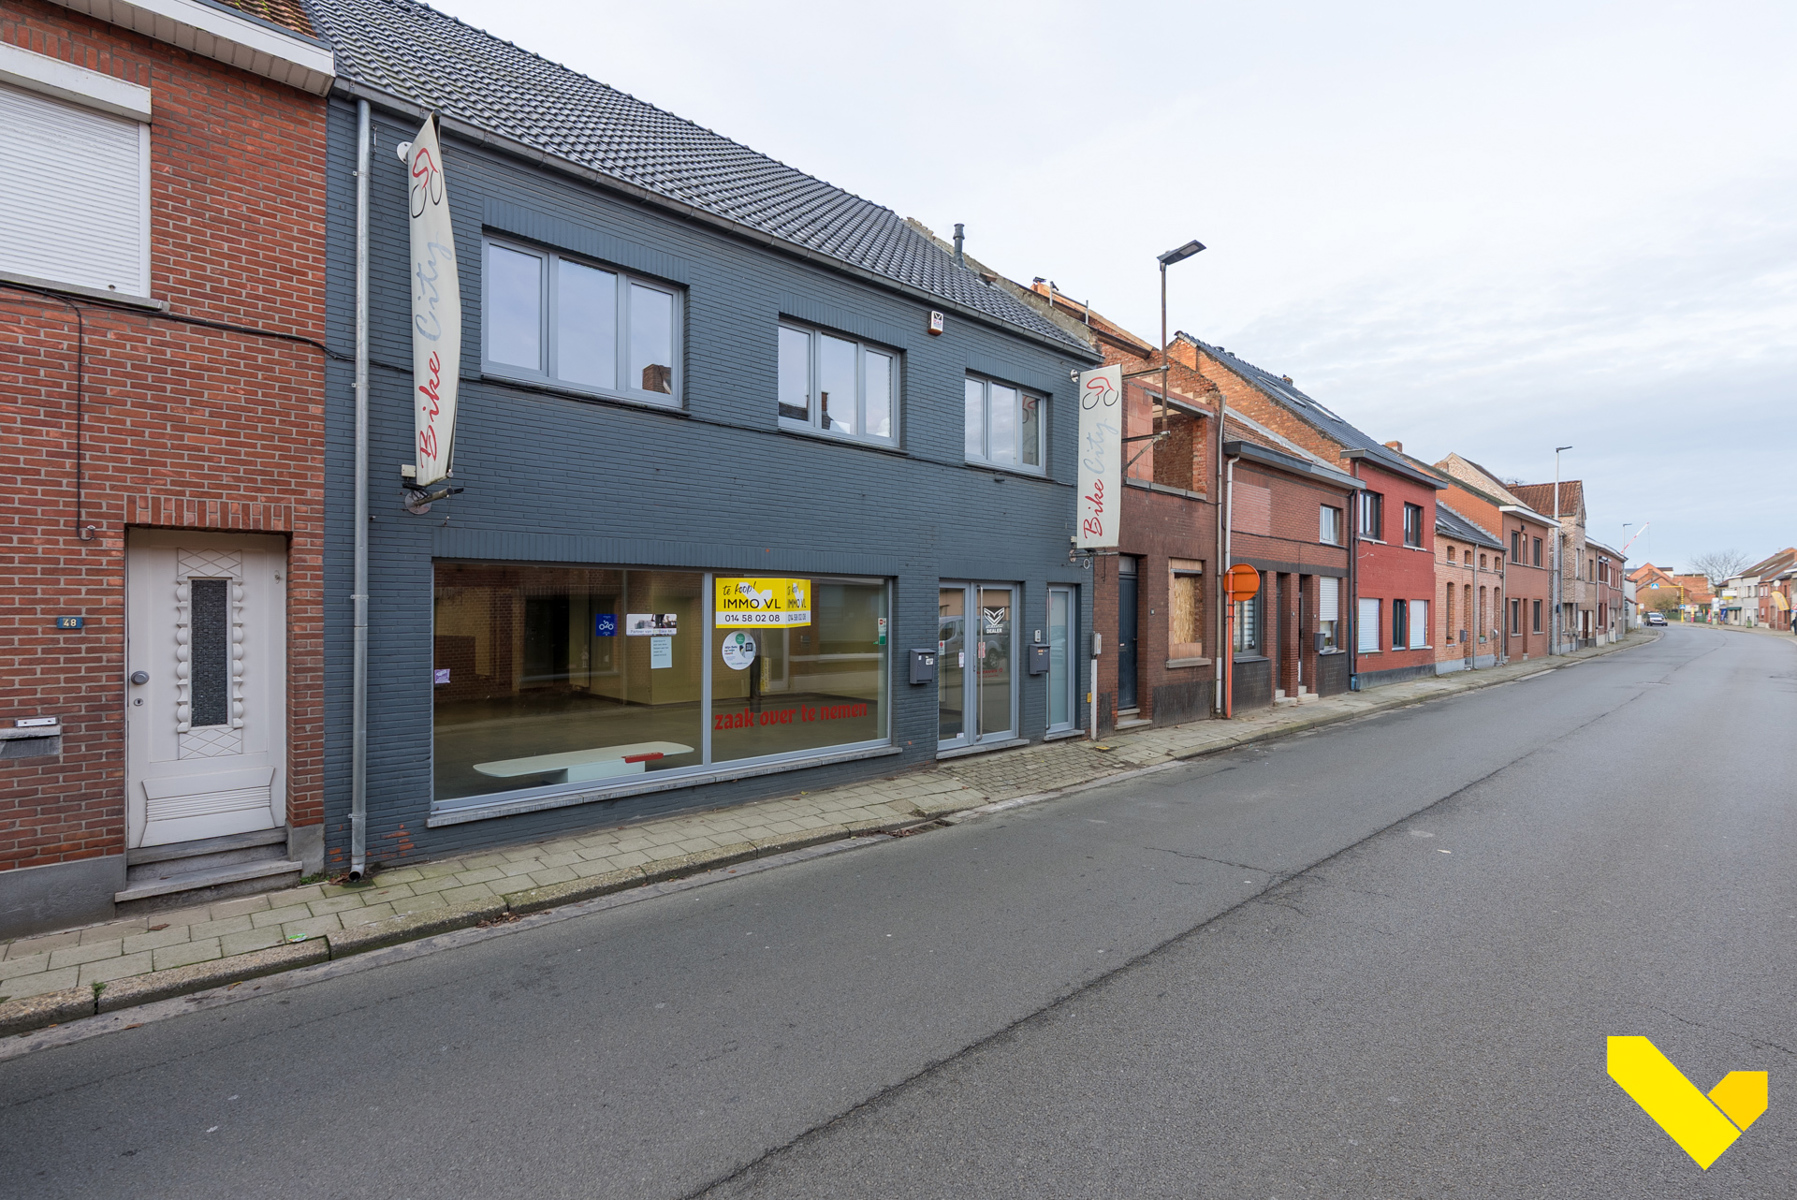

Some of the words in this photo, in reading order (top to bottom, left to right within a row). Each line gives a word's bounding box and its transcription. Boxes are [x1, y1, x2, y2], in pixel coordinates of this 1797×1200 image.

[415, 232, 453, 341] City
[418, 351, 441, 468] Bike
[1083, 418, 1119, 475] City
[1083, 479, 1104, 539] Bike
[723, 585, 731, 596] te
[735, 580, 757, 595] koop!
[723, 598, 760, 609] IMMO
[763, 598, 782, 609] VL
[63, 618, 77, 627] 48
[724, 614, 740, 623] 014
[741, 614, 753, 623] 58
[755, 614, 767, 623] 02
[768, 614, 781, 623] 08
[714, 707, 755, 730] zaak
[759, 708, 797, 726] over
[801, 704, 817, 722] te
[820, 703, 868, 721] nemen
